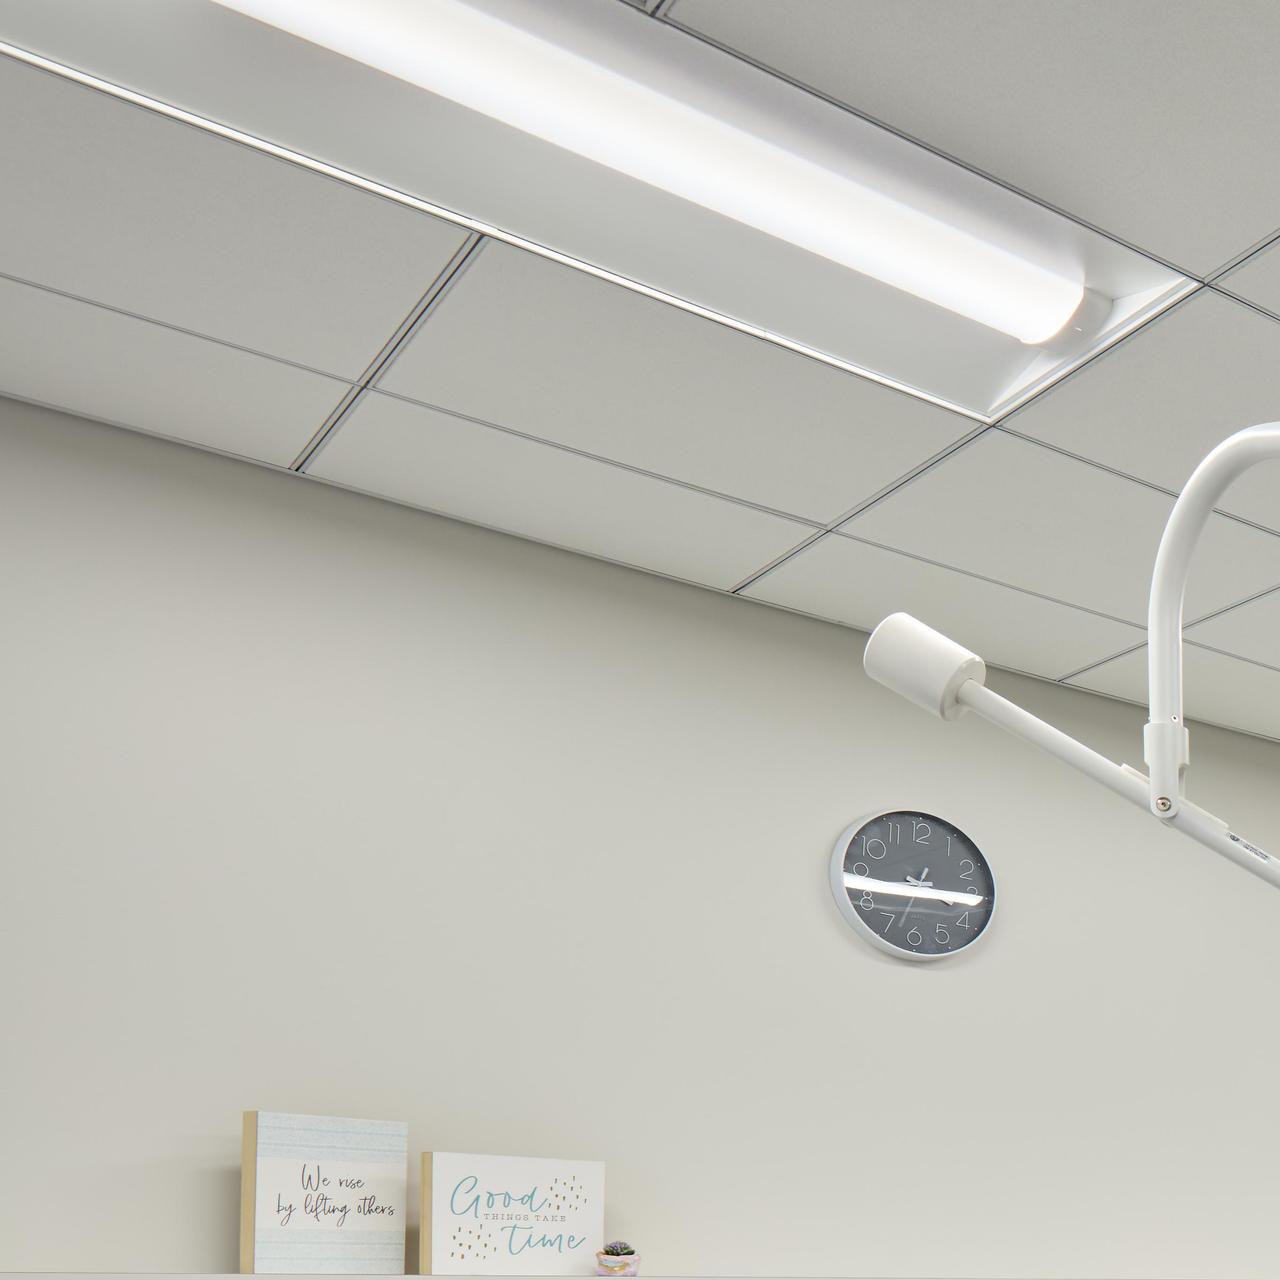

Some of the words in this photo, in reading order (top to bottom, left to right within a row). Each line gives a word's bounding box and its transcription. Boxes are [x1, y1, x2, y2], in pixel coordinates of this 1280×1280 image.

[888, 822, 900, 845] 11
[911, 820, 932, 845] 12
[862, 835, 887, 860] 10
[946, 836, 951, 857] 1
[959, 859, 975, 881] 2
[860, 890, 874, 911] 8
[879, 912, 896, 933] 7
[955, 911, 971, 931] 4
[906, 926, 923, 946] 6
[935, 923, 950, 945] 5
[301, 1163, 332, 1192] We
[338, 1176, 365, 1189] rise
[450, 1175, 548, 1219] Good
[275, 1192, 297, 1227] by
[304, 1192, 351, 1227] lifting
[357, 1195, 395, 1216] others
[484, 1213, 529, 1222] THINGS
[534, 1214, 567, 1222] TAKE
[500, 1223, 587, 1256] time
